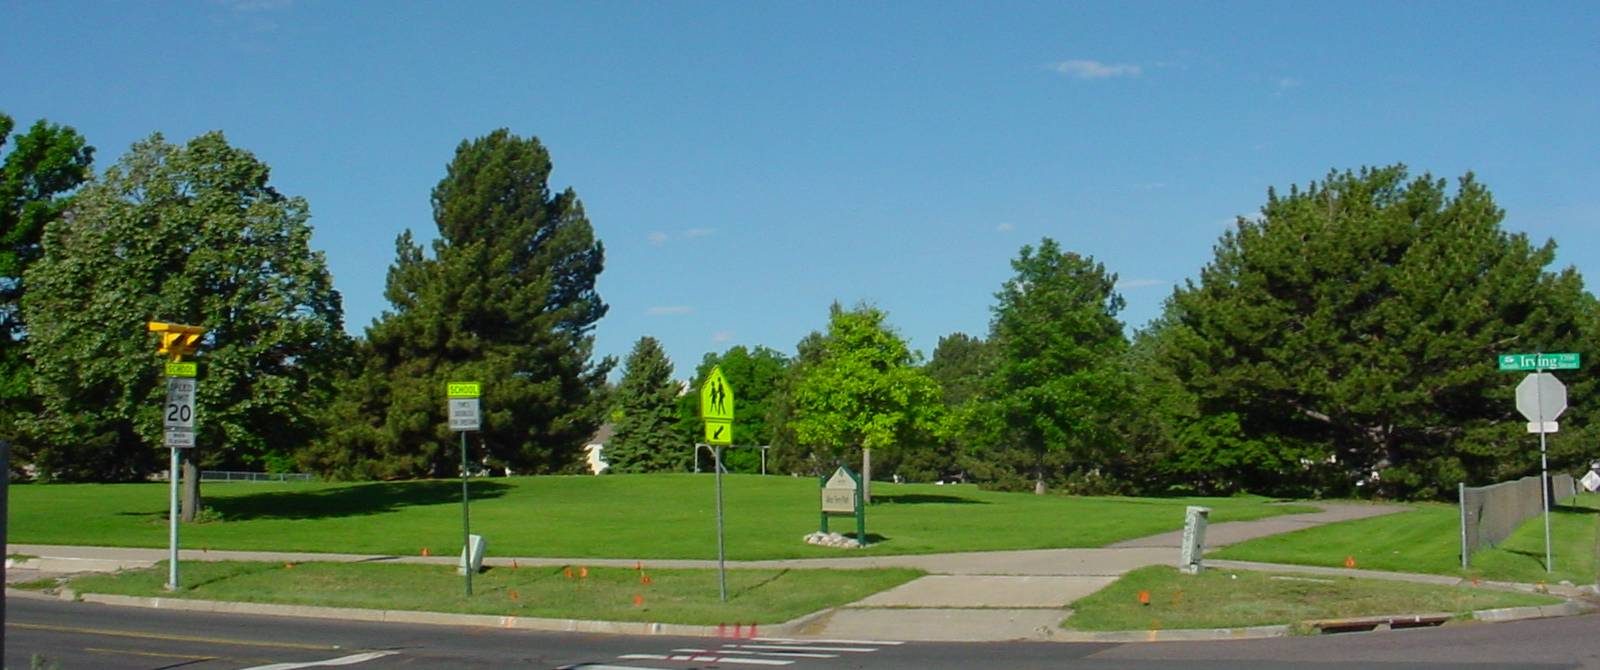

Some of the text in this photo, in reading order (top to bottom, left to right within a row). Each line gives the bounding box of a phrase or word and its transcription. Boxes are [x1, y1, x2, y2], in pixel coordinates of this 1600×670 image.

[1520, 355, 1558, 370] Irving
[168, 365, 193, 374] SCHOOL
[450, 385, 477, 394] SCHOOL
[168, 404, 191, 422] 20
